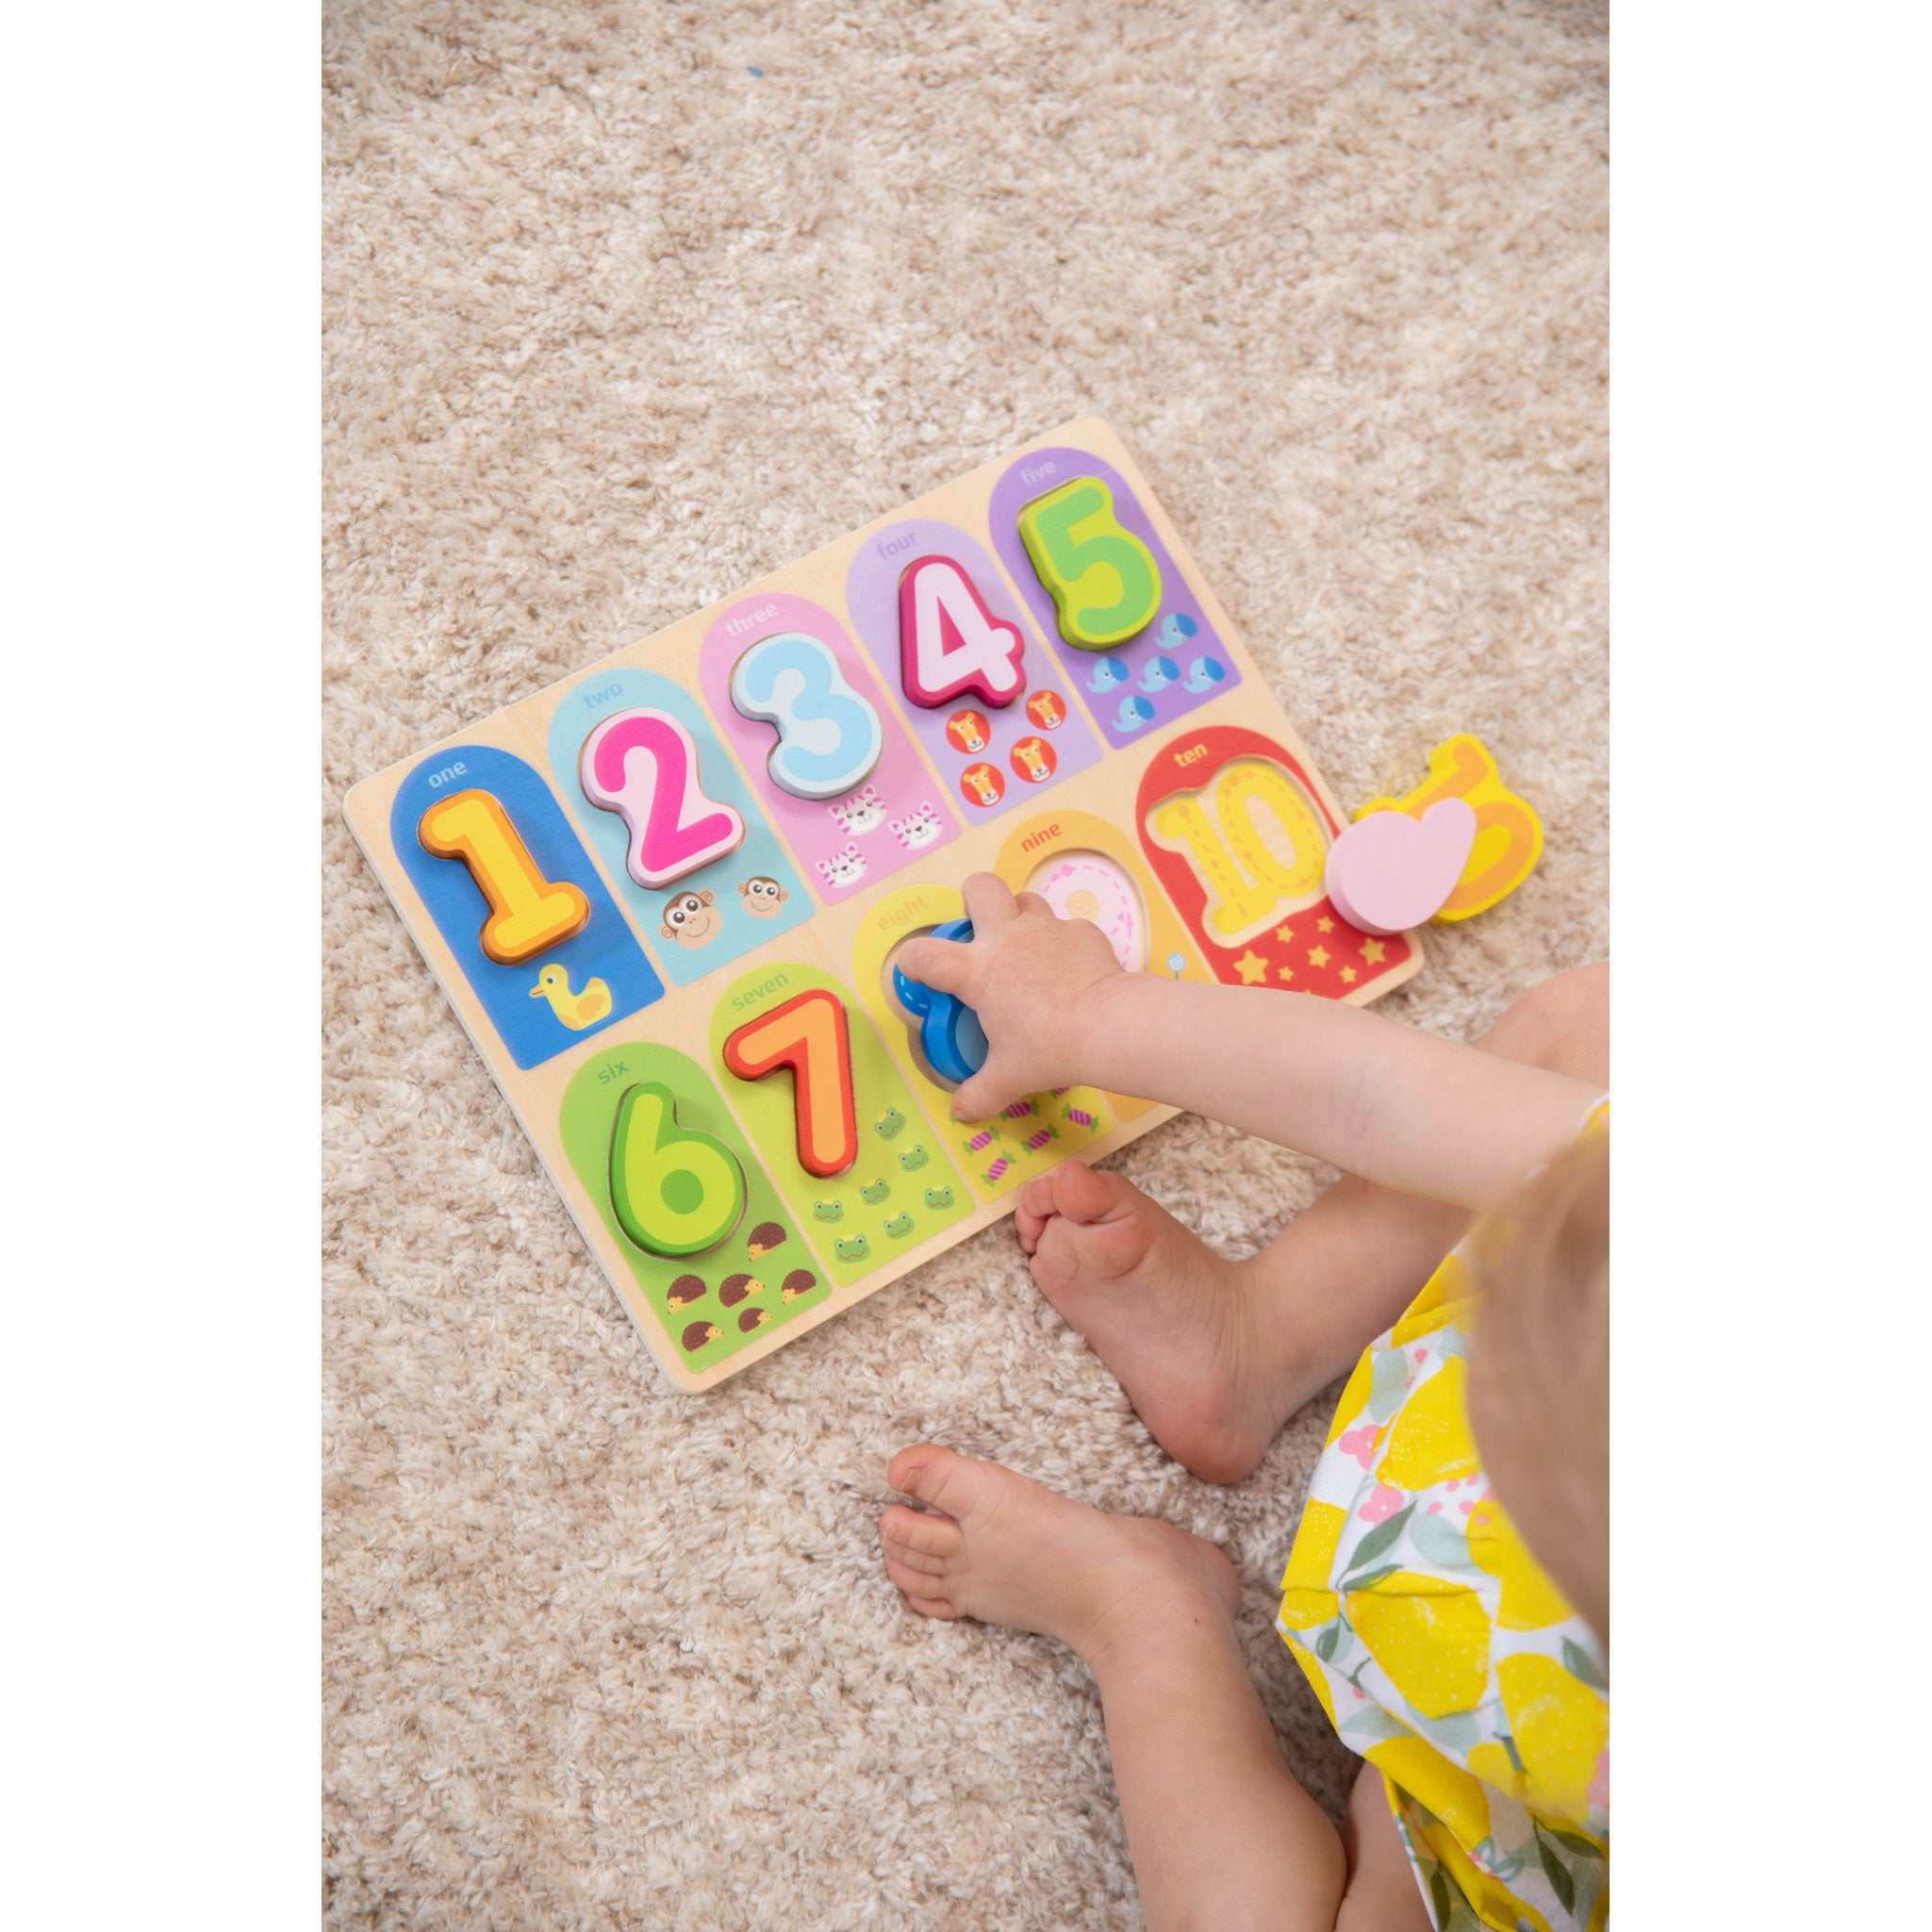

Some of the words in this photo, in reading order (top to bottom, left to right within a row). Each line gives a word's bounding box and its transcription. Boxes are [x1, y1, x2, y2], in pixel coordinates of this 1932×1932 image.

[1020, 459, 1057, 487] five
[877, 531, 917, 560] four
[1035, 486, 1155, 637] 5
[724, 601, 781, 638] three
[914, 562, 1017, 693] 4
[582, 681, 623, 710] two
[745, 639, 873, 783] 3
[428, 760, 467, 788] one
[1174, 742, 1208, 768] ten
[593, 716, 735, 873] 2
[1021, 821, 1063, 853] nine
[1156, 763, 1322, 934] 10
[431, 798, 576, 949] 1
[878, 895, 929, 931] eight
[732, 971, 789, 1012] seven
[598, 1059, 629, 1084] six
[736, 997, 846, 1164] 7
[623, 1092, 736, 1245] 6
